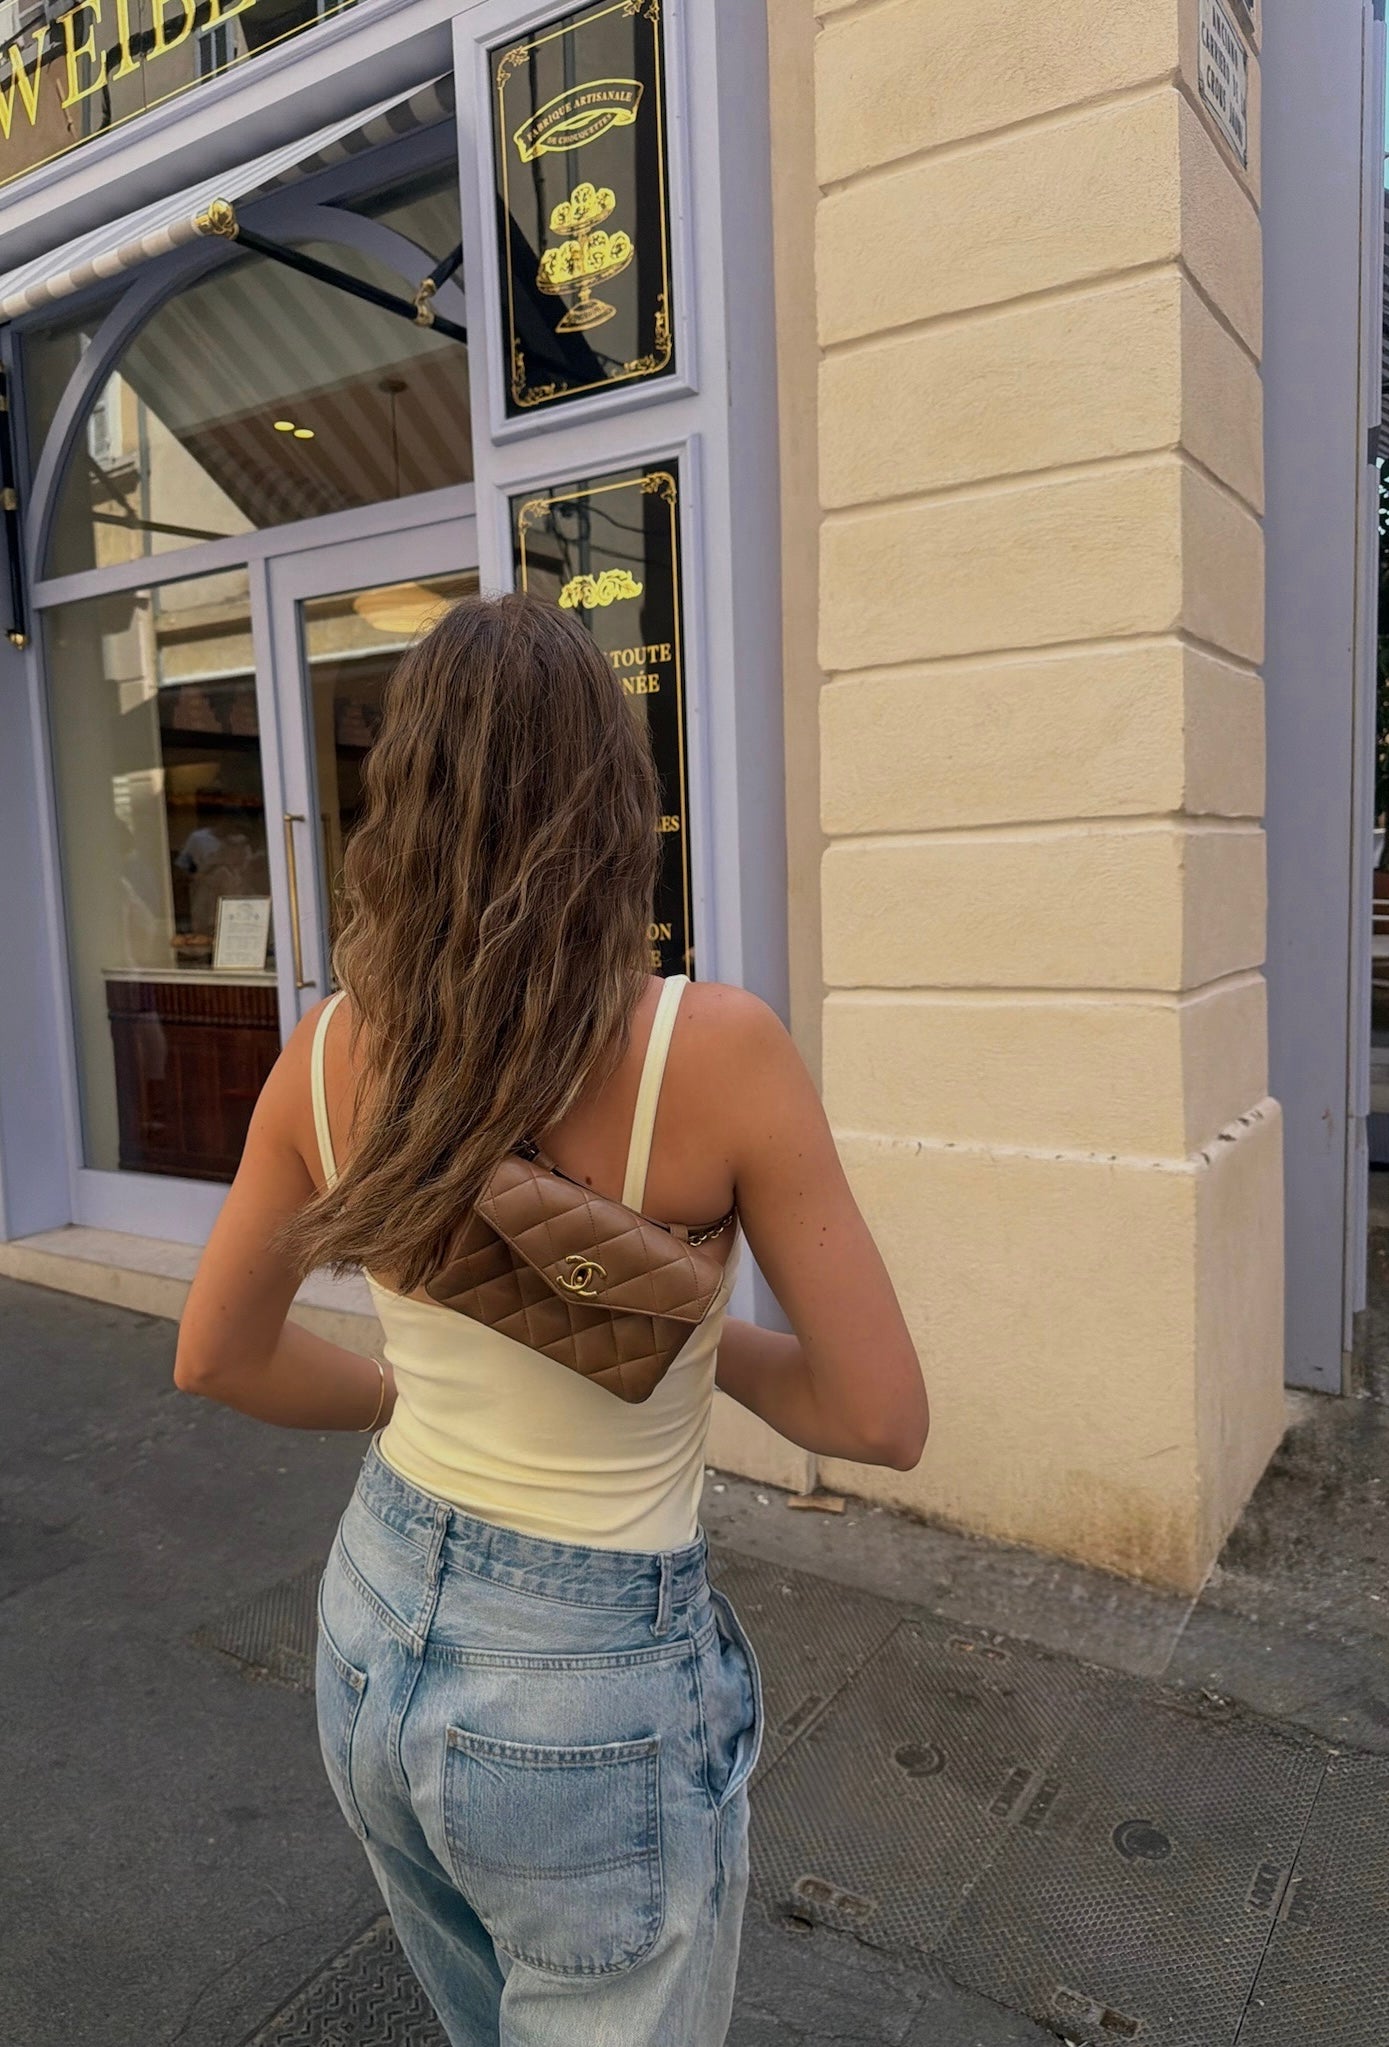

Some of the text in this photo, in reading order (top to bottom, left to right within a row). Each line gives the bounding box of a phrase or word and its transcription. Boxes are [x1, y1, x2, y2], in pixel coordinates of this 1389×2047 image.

[526, 91, 633, 142] FABRIQUE ARTISANALE
[609, 642, 672, 668] TOUTE
